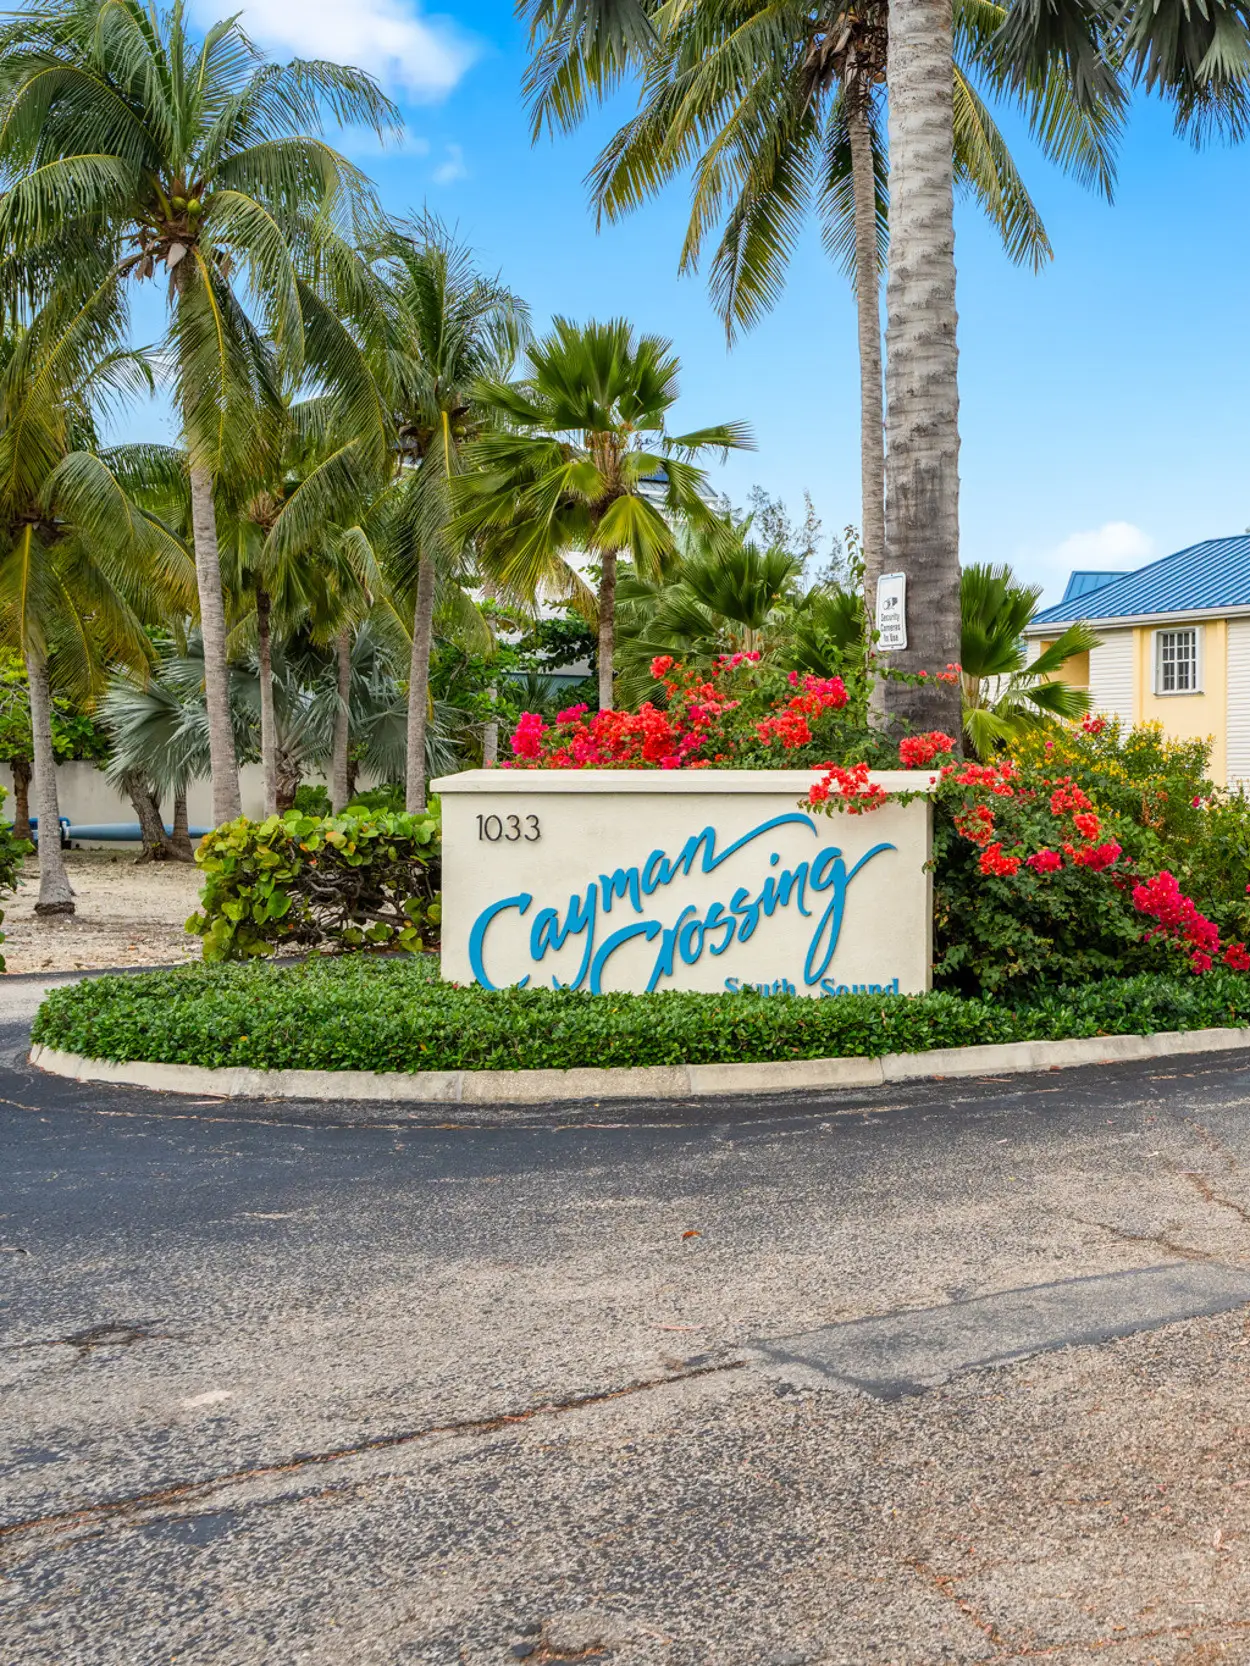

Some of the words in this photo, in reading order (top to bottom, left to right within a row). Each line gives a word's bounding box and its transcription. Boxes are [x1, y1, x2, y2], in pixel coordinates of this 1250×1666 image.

[880, 623, 901, 632] Cameras
[881, 613, 900, 621] Security
[476, 814, 541, 841] 1033
[469, 812, 818, 993] Cayman
[590, 842, 897, 996] Crossing
